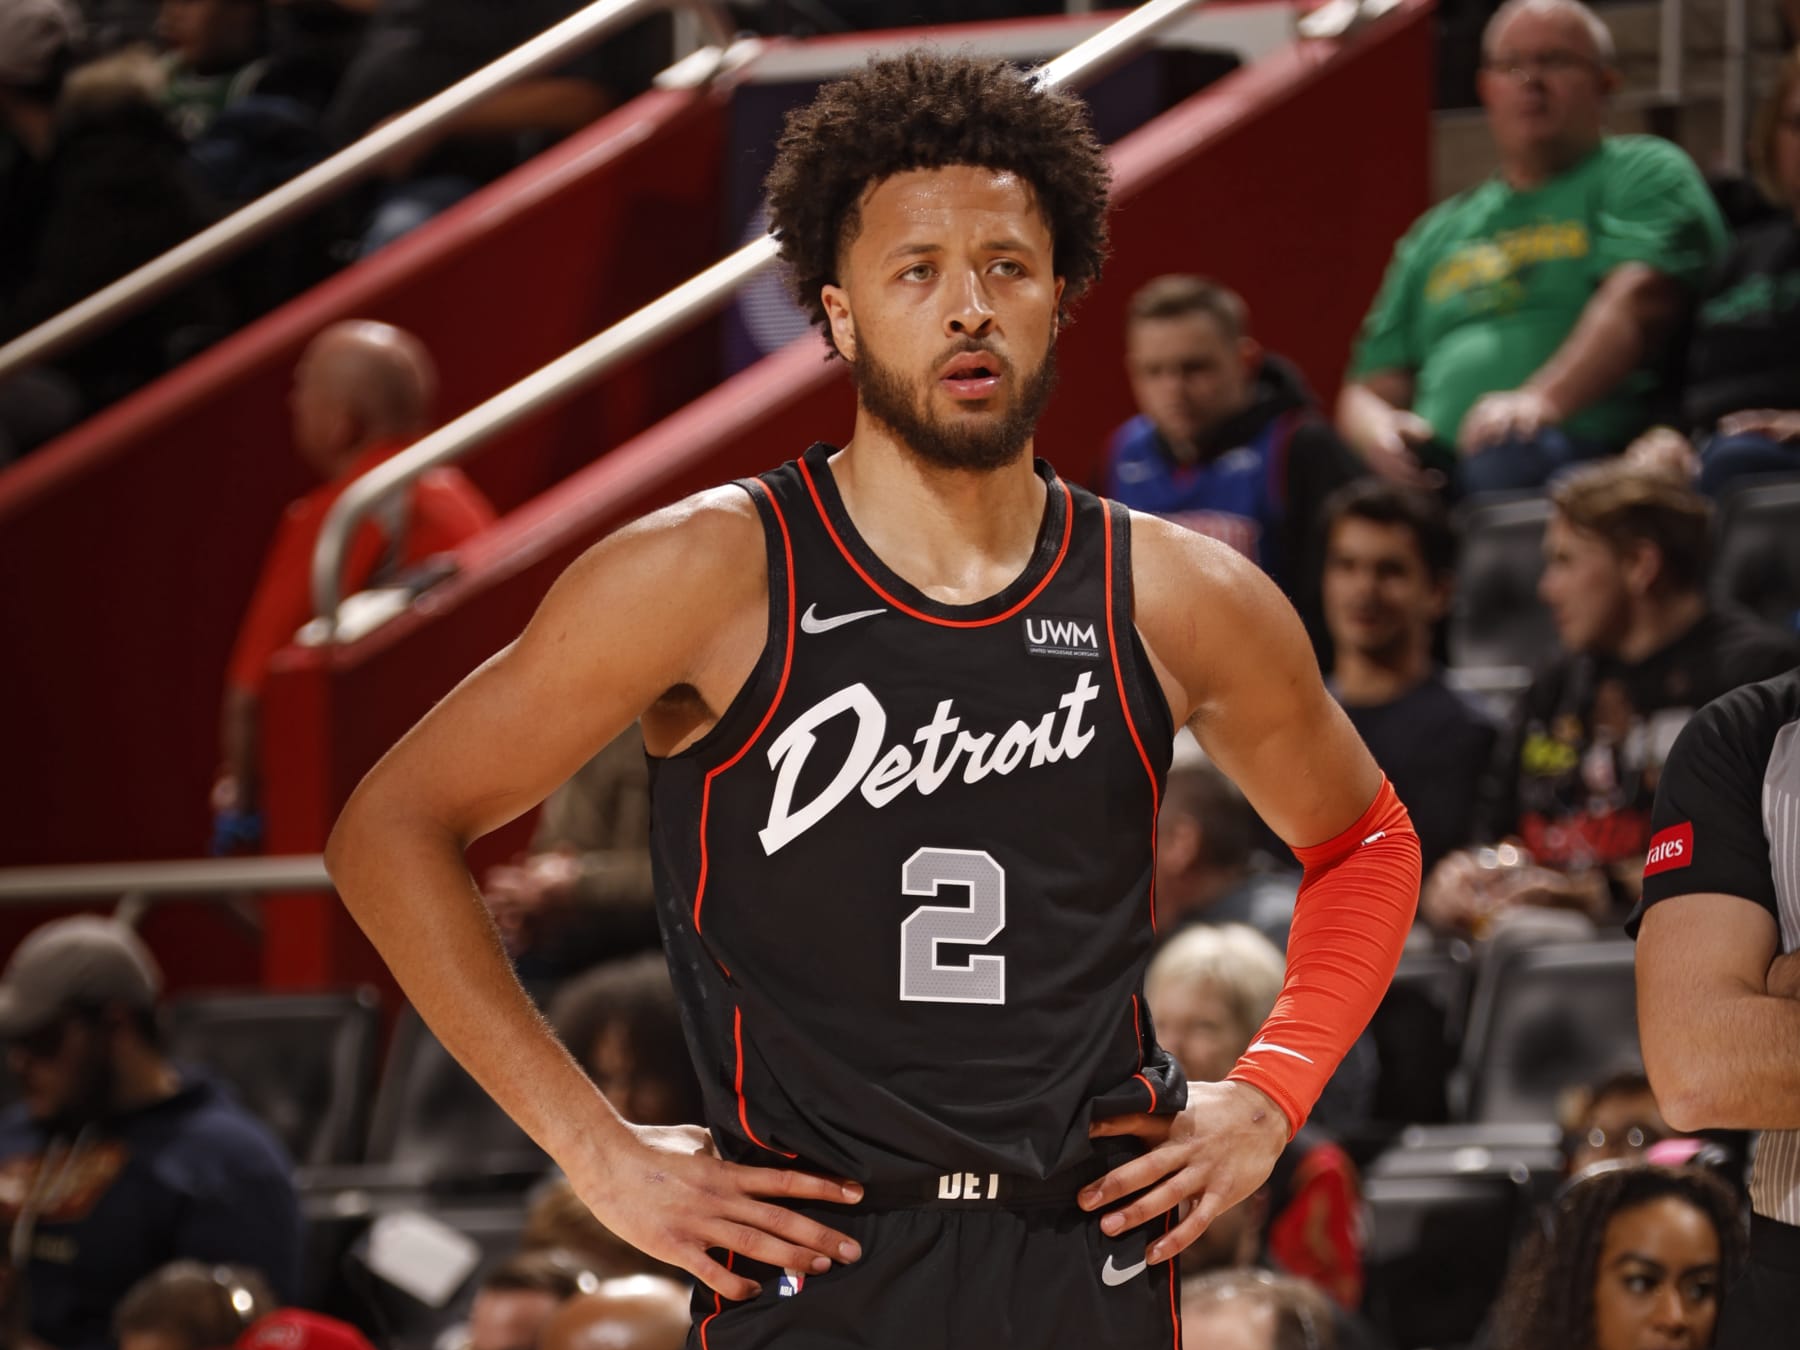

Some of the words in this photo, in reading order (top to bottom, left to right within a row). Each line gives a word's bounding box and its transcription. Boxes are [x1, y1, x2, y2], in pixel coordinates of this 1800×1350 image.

[1026, 618, 1098, 649] UWM
[758, 671, 1100, 856] Detroit
[900, 847, 1005, 1005] 2
